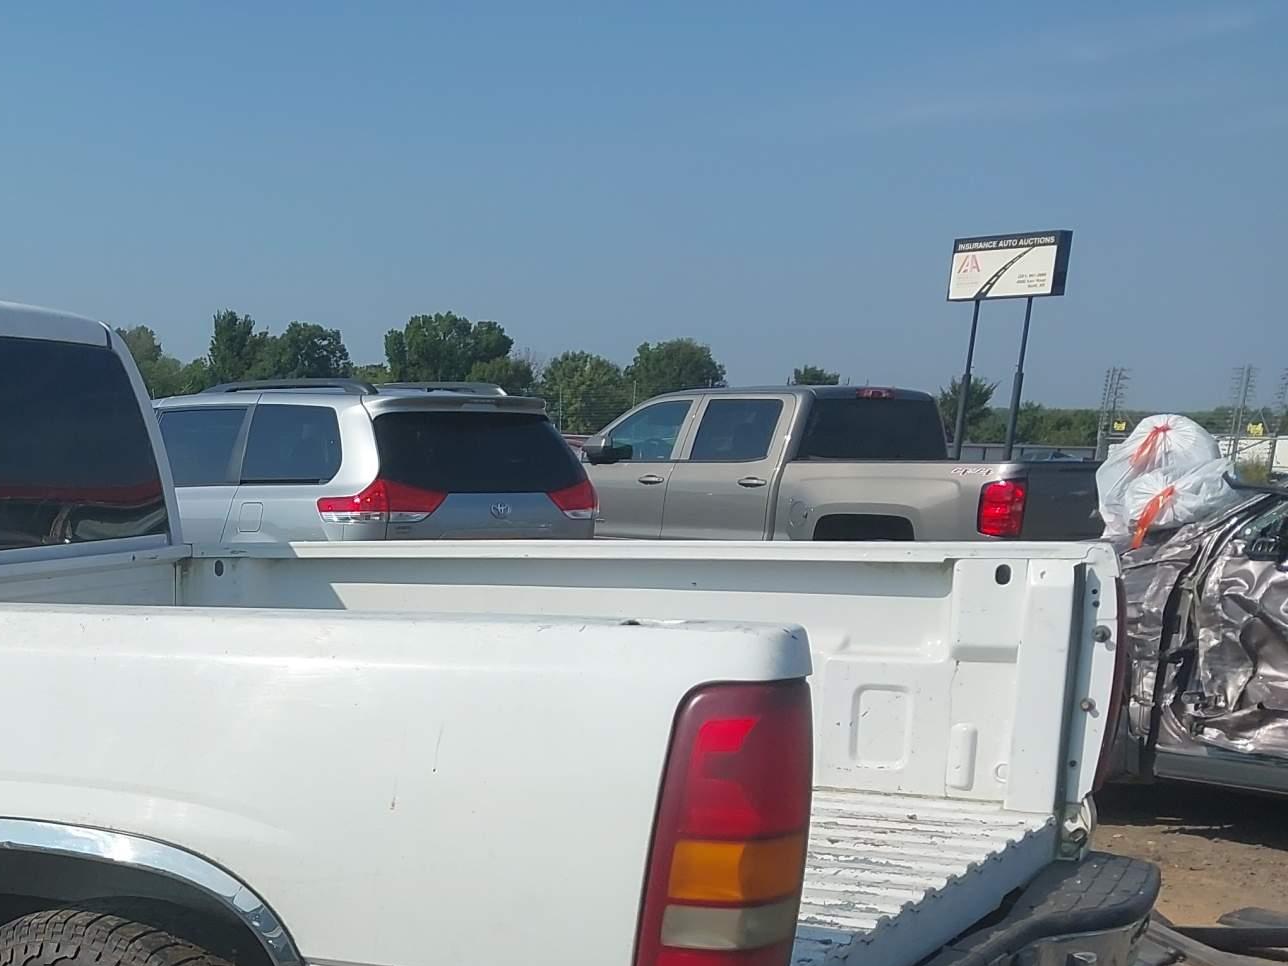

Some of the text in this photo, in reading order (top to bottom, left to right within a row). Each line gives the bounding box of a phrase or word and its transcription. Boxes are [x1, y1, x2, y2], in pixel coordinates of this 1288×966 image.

[958, 236, 1056, 251] INSURANCE AUTO AUCTIONS
